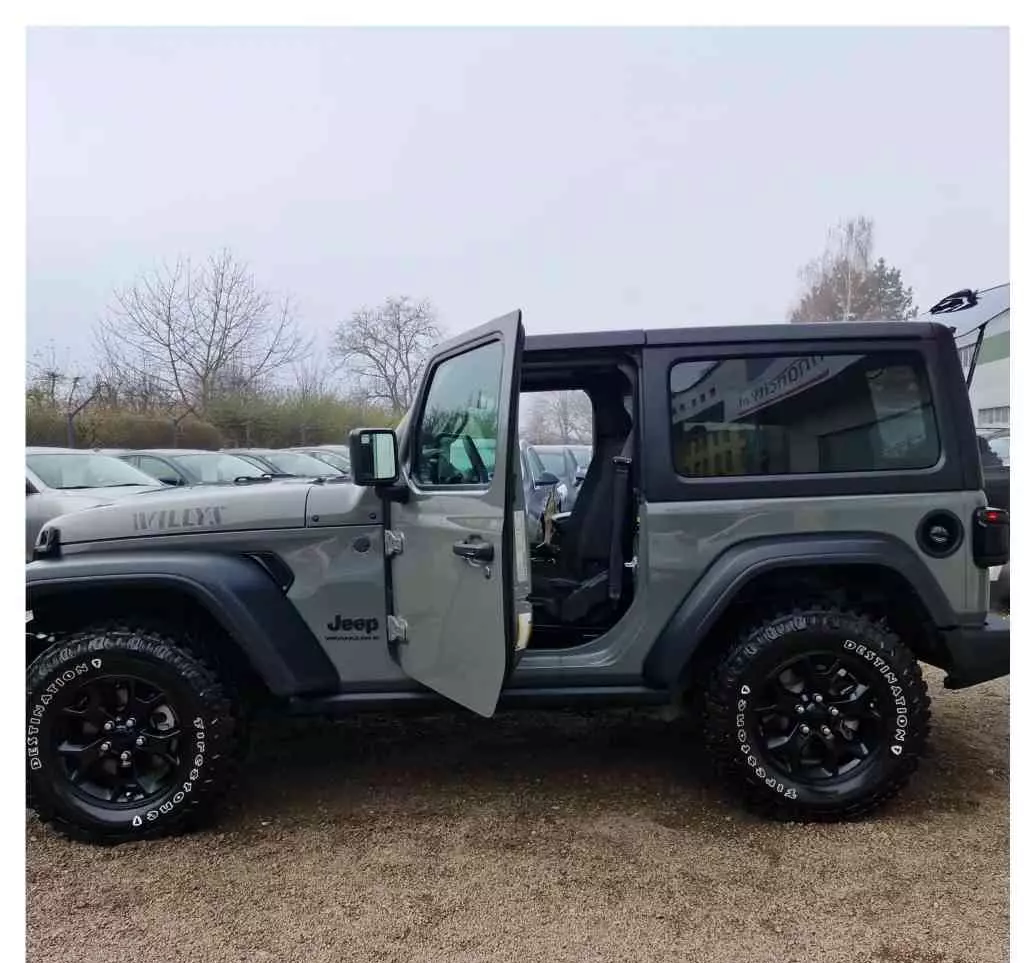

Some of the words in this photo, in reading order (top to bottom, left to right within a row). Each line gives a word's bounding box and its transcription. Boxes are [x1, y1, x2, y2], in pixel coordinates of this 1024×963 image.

[132, 506, 227, 531] WILLYS
[327, 614, 379, 634] Jeep
[27, 663, 89, 770] DESTINATION
[844, 639, 908, 742] DESTINATION
